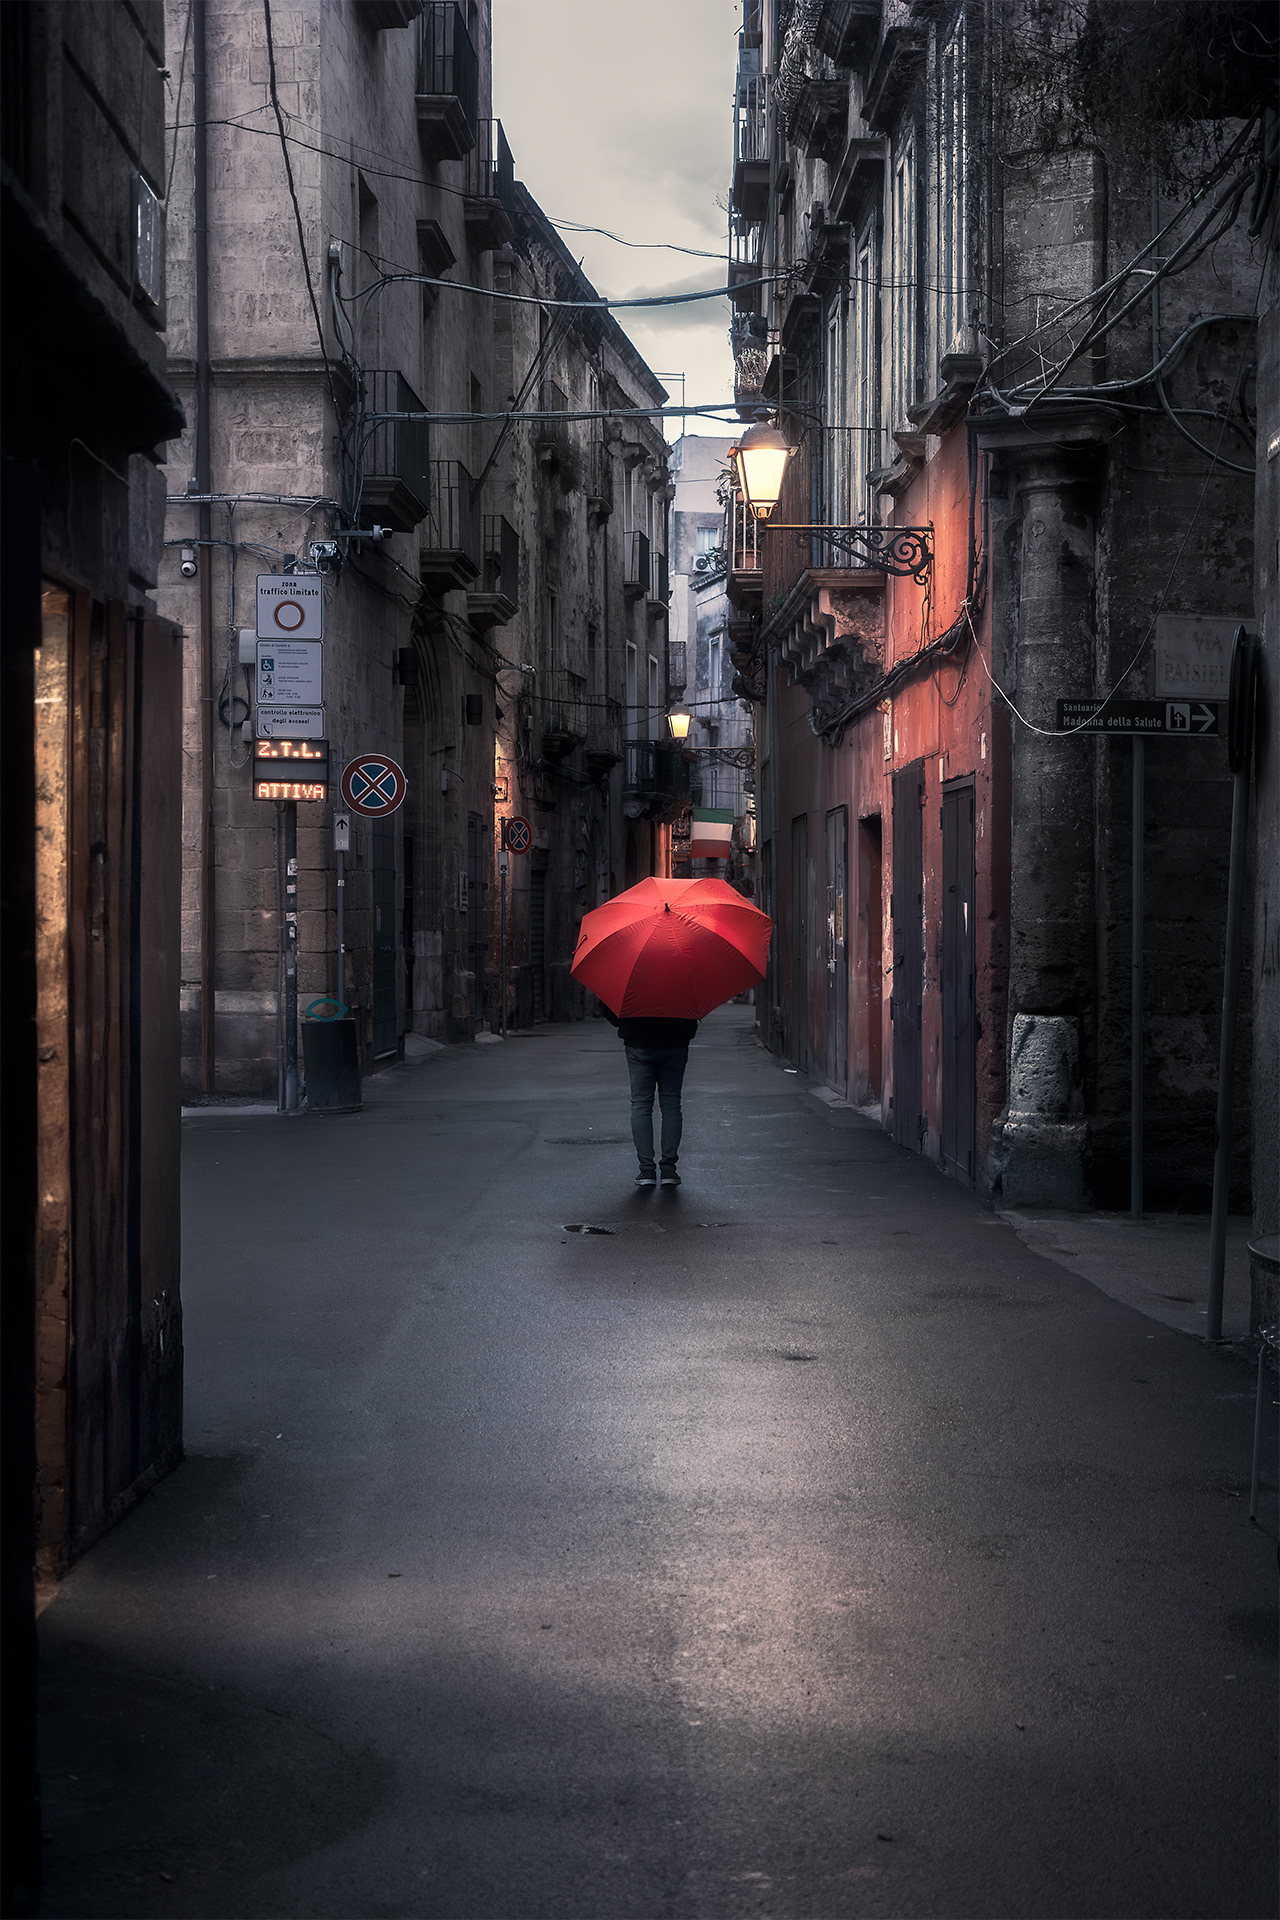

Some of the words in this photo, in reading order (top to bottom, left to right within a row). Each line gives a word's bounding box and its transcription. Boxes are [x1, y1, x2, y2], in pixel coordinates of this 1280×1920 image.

[260, 588, 288, 596] traffico
[290, 588, 319, 596] limitato
[1193, 631, 1224, 652] VIA
[1063, 703, 1101, 712] Santuario
[272, 717, 287, 725] degli
[1107, 716, 1131, 727] della
[1134, 717, 1162, 728] Salute
[258, 741, 322, 758] Z.T.L.
[258, 783, 324, 799] ATTIVA
